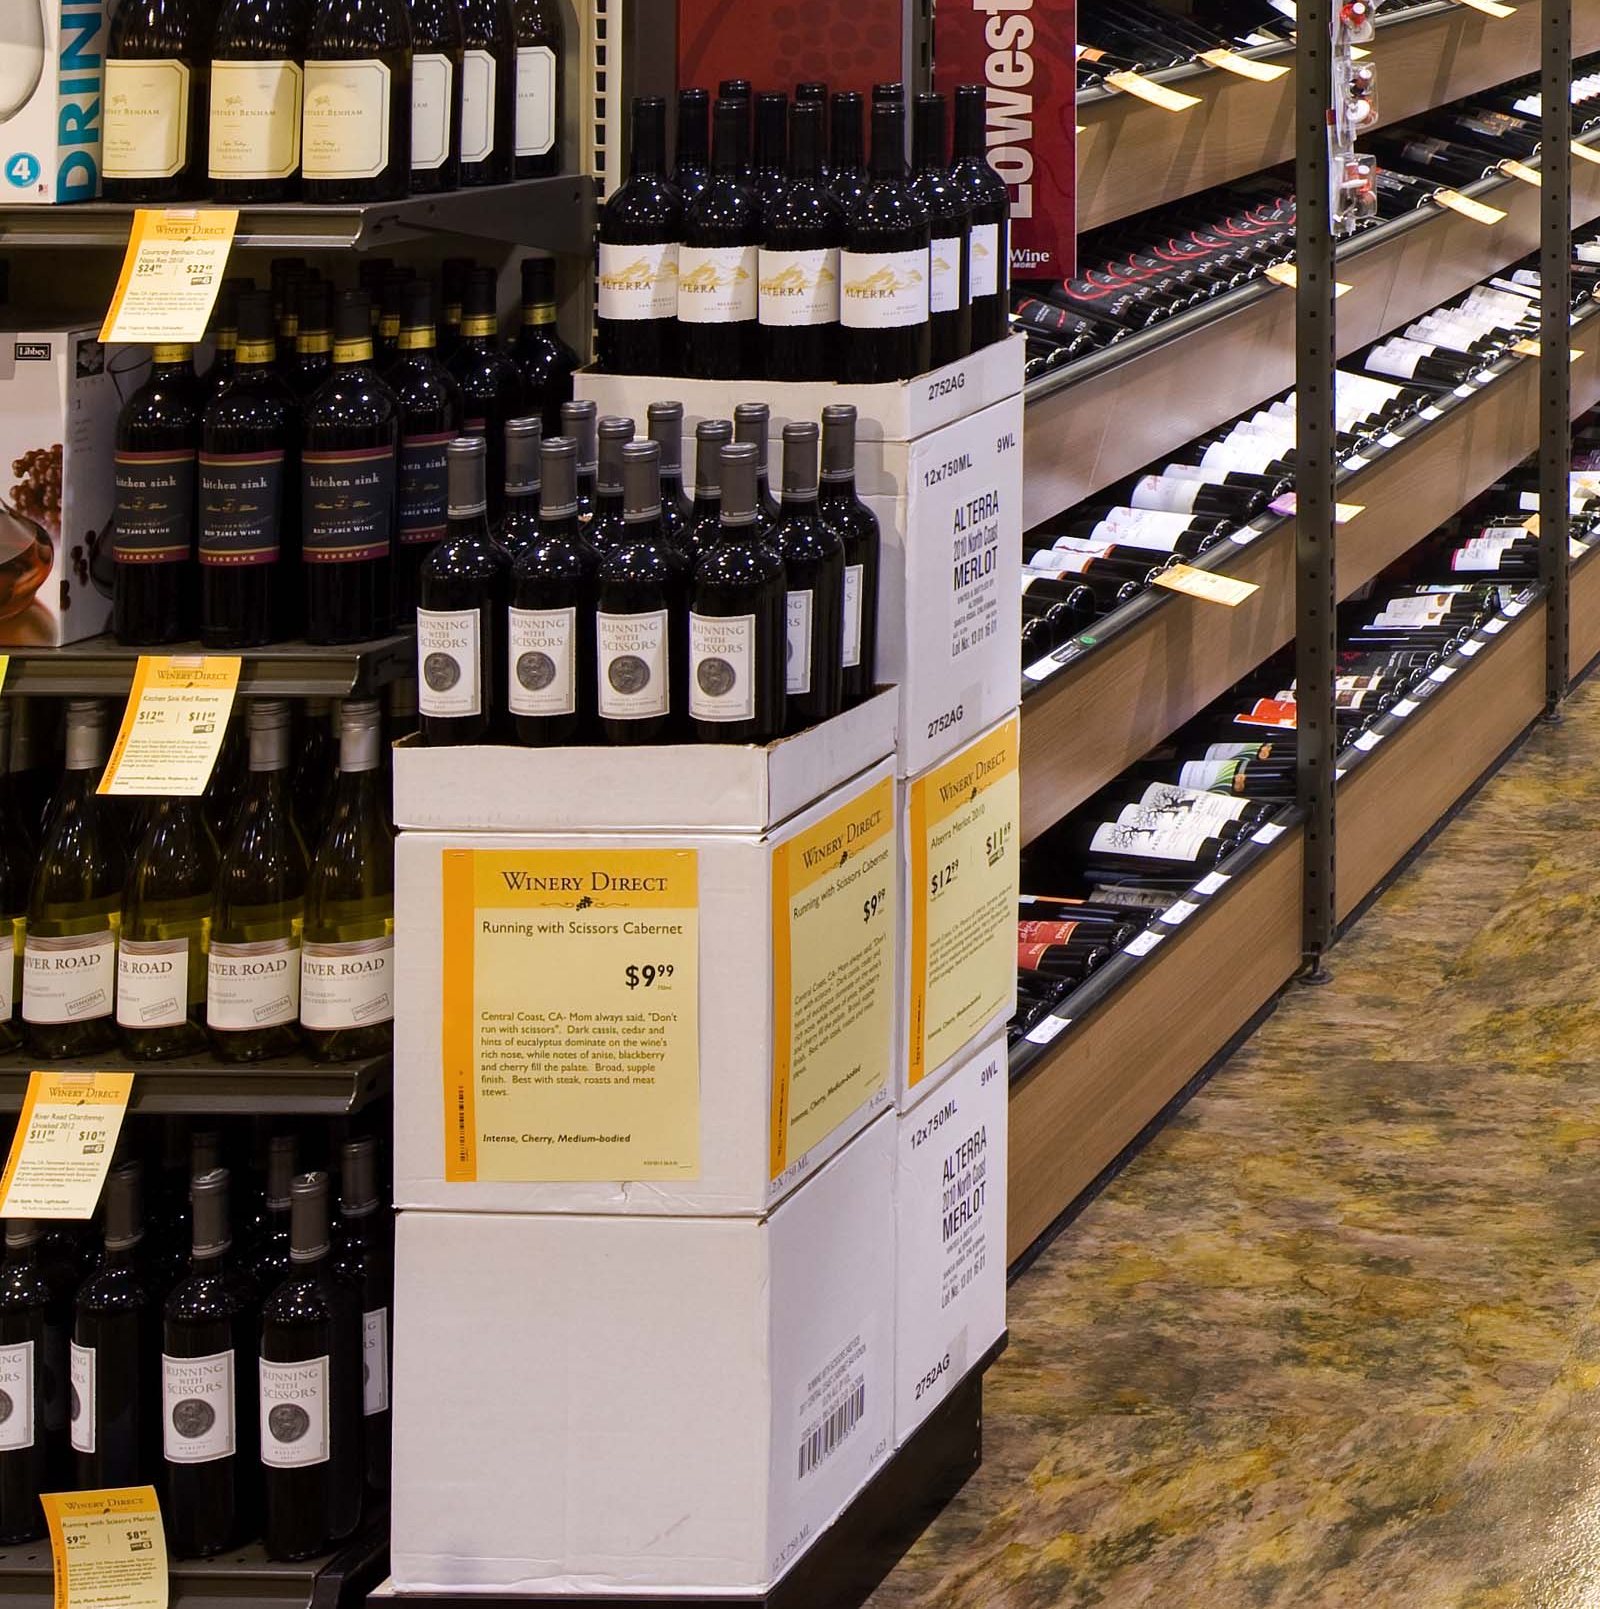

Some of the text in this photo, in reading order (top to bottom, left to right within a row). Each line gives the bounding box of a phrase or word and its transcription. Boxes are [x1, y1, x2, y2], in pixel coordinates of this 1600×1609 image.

[923, 432, 1016, 488] 12x750ML 9WL
[310, 472, 380, 486] kitchen sink
[954, 490, 999, 534] ALTERRA
[954, 546, 998, 591] MERLOT
[927, 703, 964, 739] 2752AG
[501, 871, 668, 892] WINERY DIRECT
[482, 921, 683, 937] Running with Scissors Cabernet
[341, 958, 385, 975] ROAD
